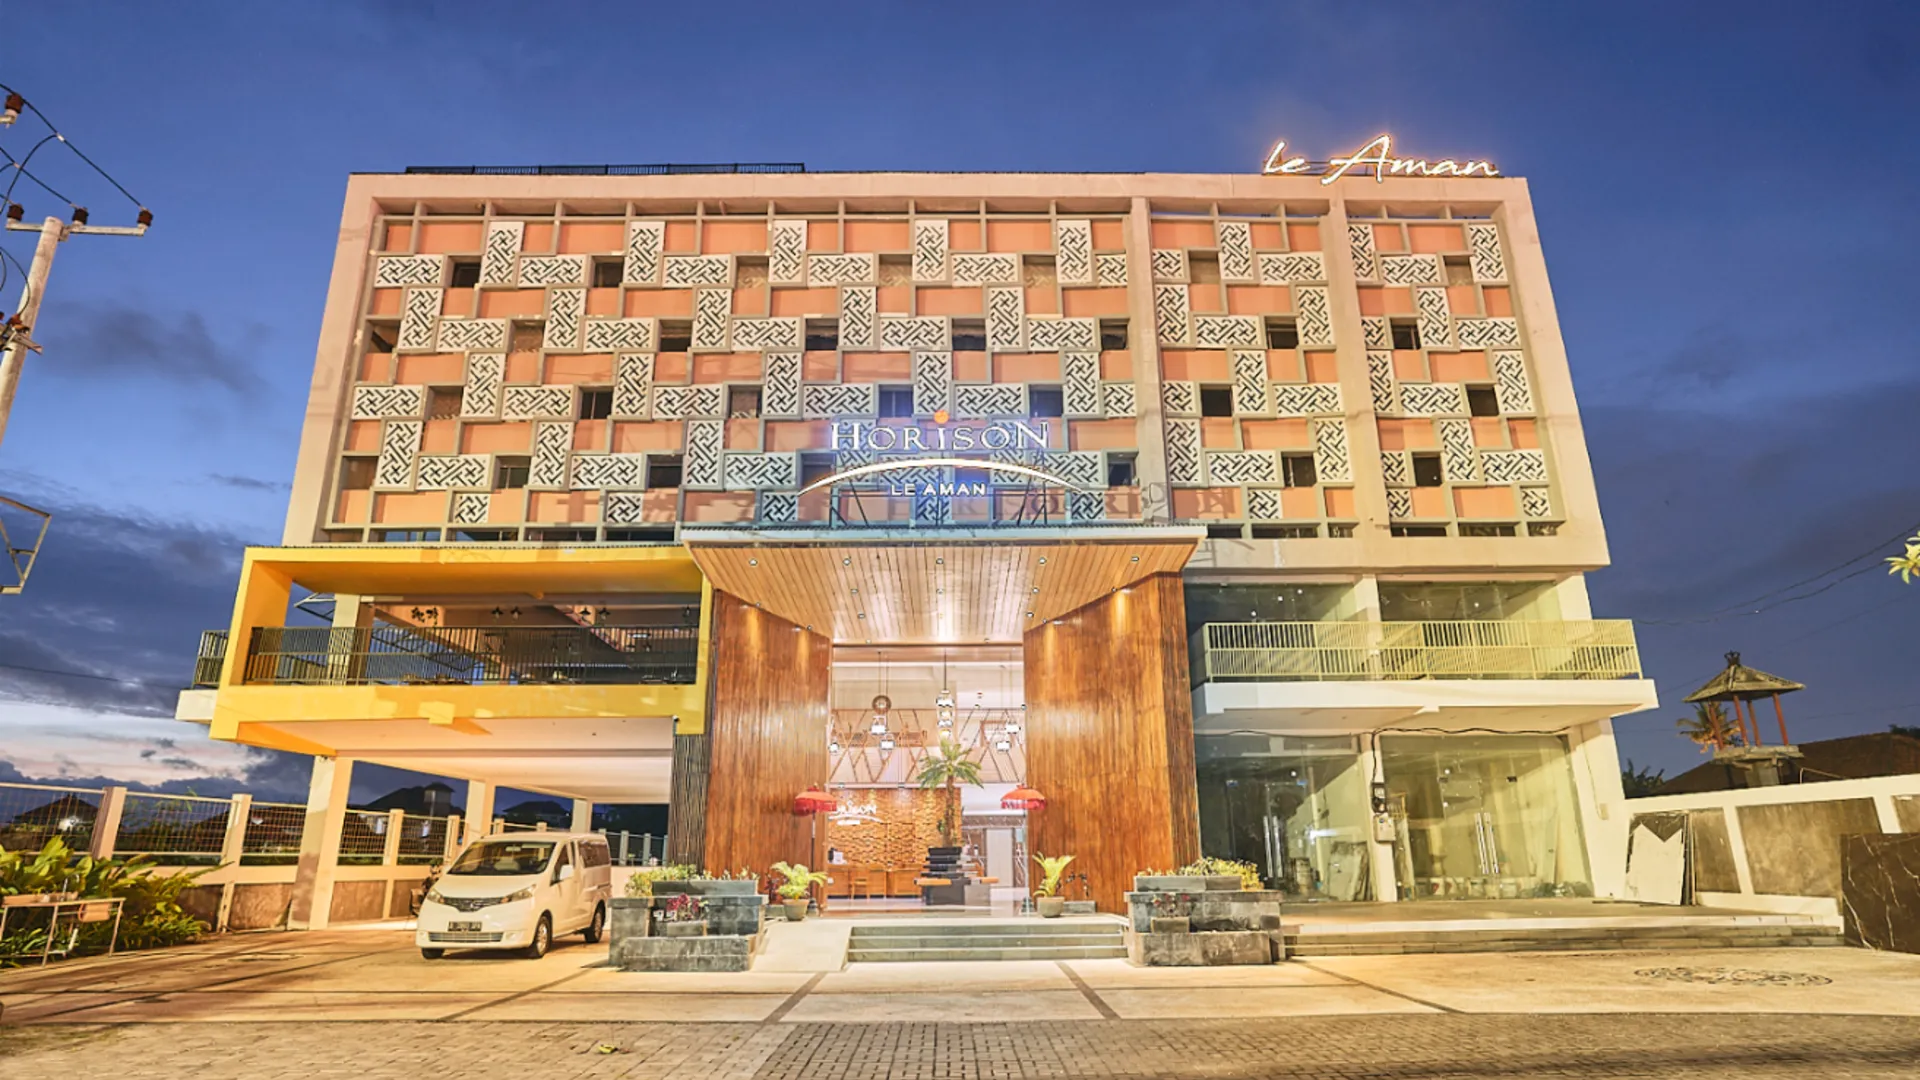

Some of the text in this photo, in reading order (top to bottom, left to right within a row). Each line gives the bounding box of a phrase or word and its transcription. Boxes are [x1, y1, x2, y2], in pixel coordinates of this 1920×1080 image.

[1321, 135, 1499, 185] Aman
[831, 421, 1048, 450] HORISON
[891, 483, 986, 496] LE AMAN
